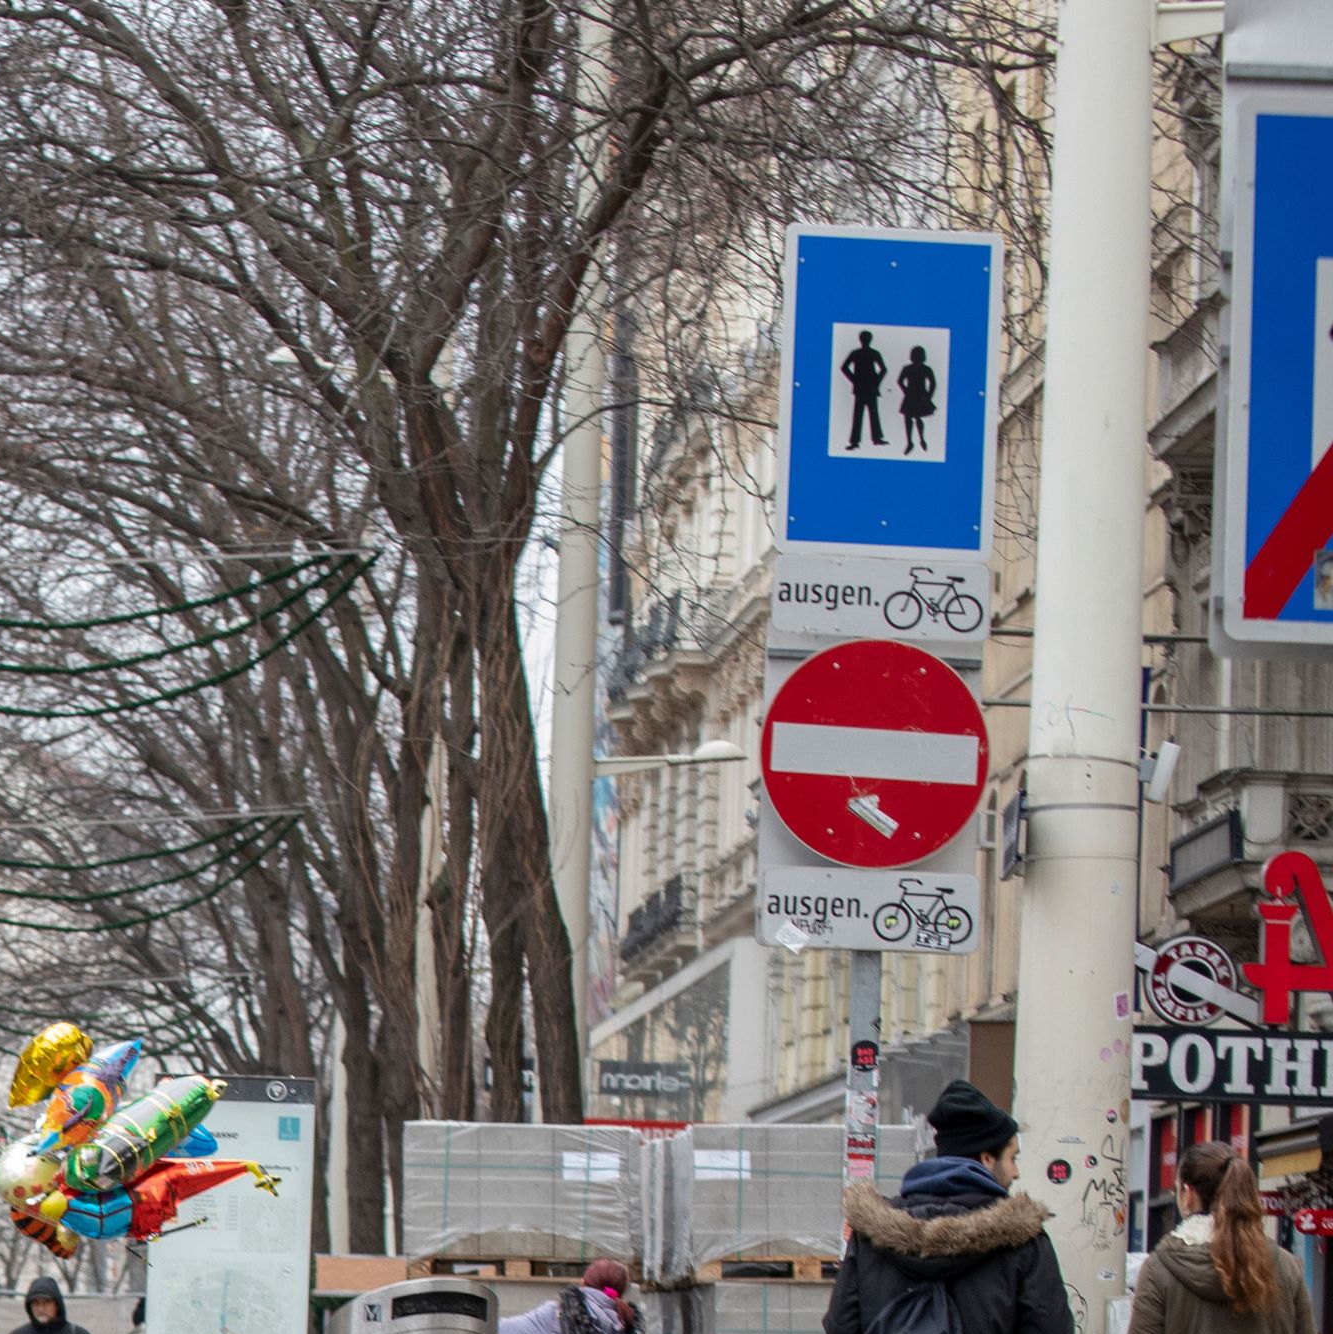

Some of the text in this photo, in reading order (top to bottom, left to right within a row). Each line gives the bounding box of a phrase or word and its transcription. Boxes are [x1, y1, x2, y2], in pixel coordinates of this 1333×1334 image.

[777, 581, 880, 611] ausgen.
[767, 894, 870, 920] ausgen.
[1169, 943, 1231, 979] TABAK
[1152, 973, 1212, 1022] TRAFIK
[1131, 1032, 1333, 1096] POTH
